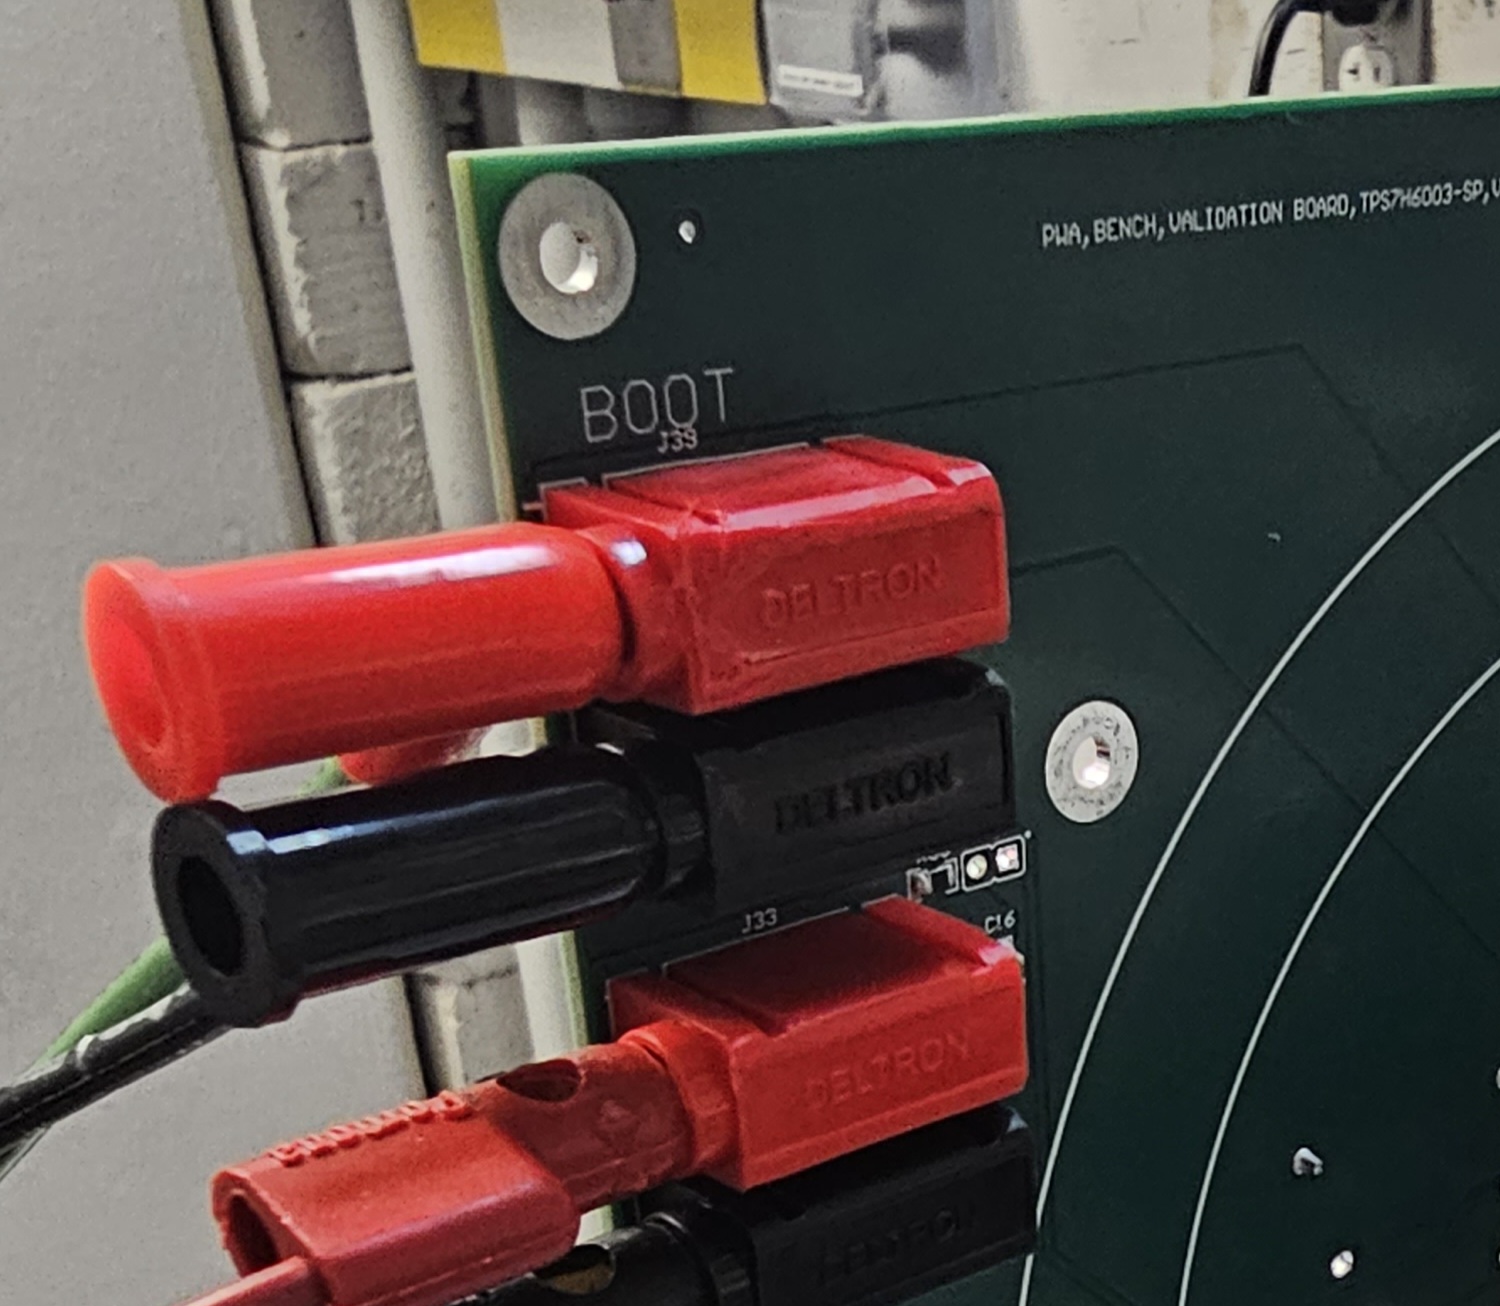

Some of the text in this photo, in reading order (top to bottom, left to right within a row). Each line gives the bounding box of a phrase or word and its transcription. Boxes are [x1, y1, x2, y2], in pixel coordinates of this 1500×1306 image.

[580, 368, 734, 443] BOOT
[774, 750, 954, 834] DELTRON
[741, 907, 778, 934] J33
